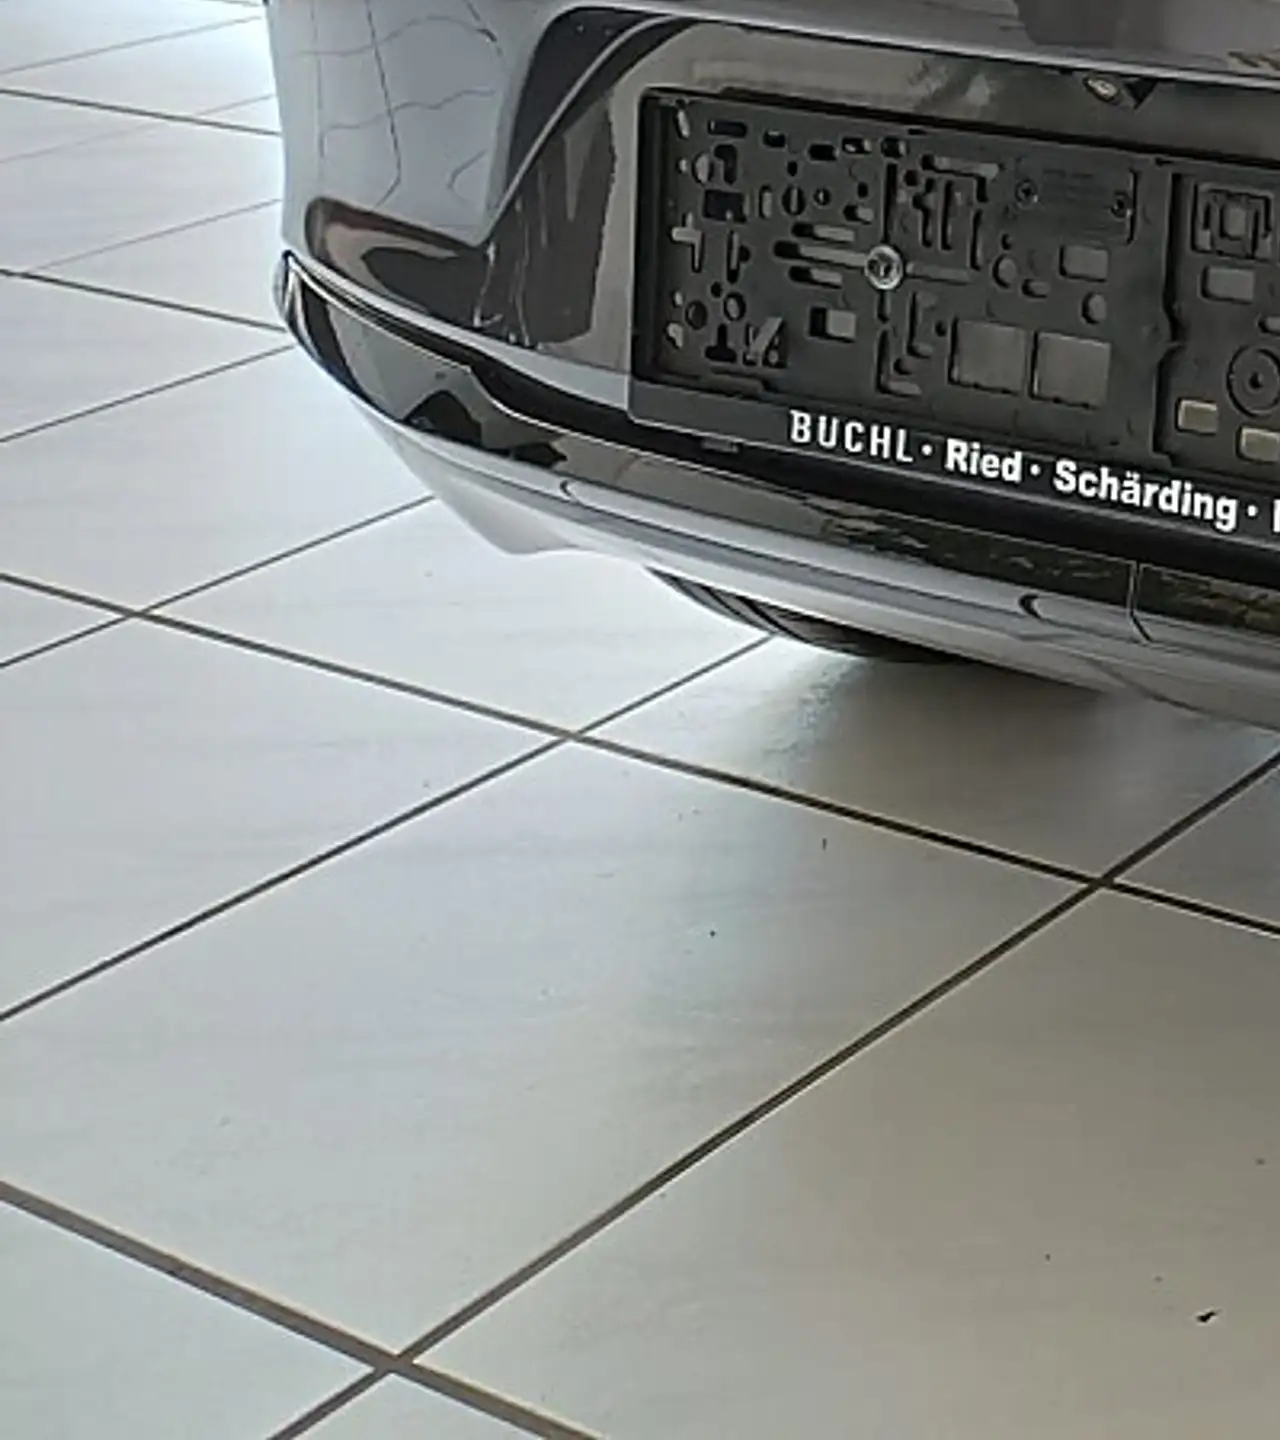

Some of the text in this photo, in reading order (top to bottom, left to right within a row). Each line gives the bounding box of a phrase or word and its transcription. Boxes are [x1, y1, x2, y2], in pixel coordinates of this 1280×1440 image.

[789, 409, 914, 463] BUCHL
[944, 437, 1023, 484] Ried
[1053, 458, 1238, 533] Schärding
